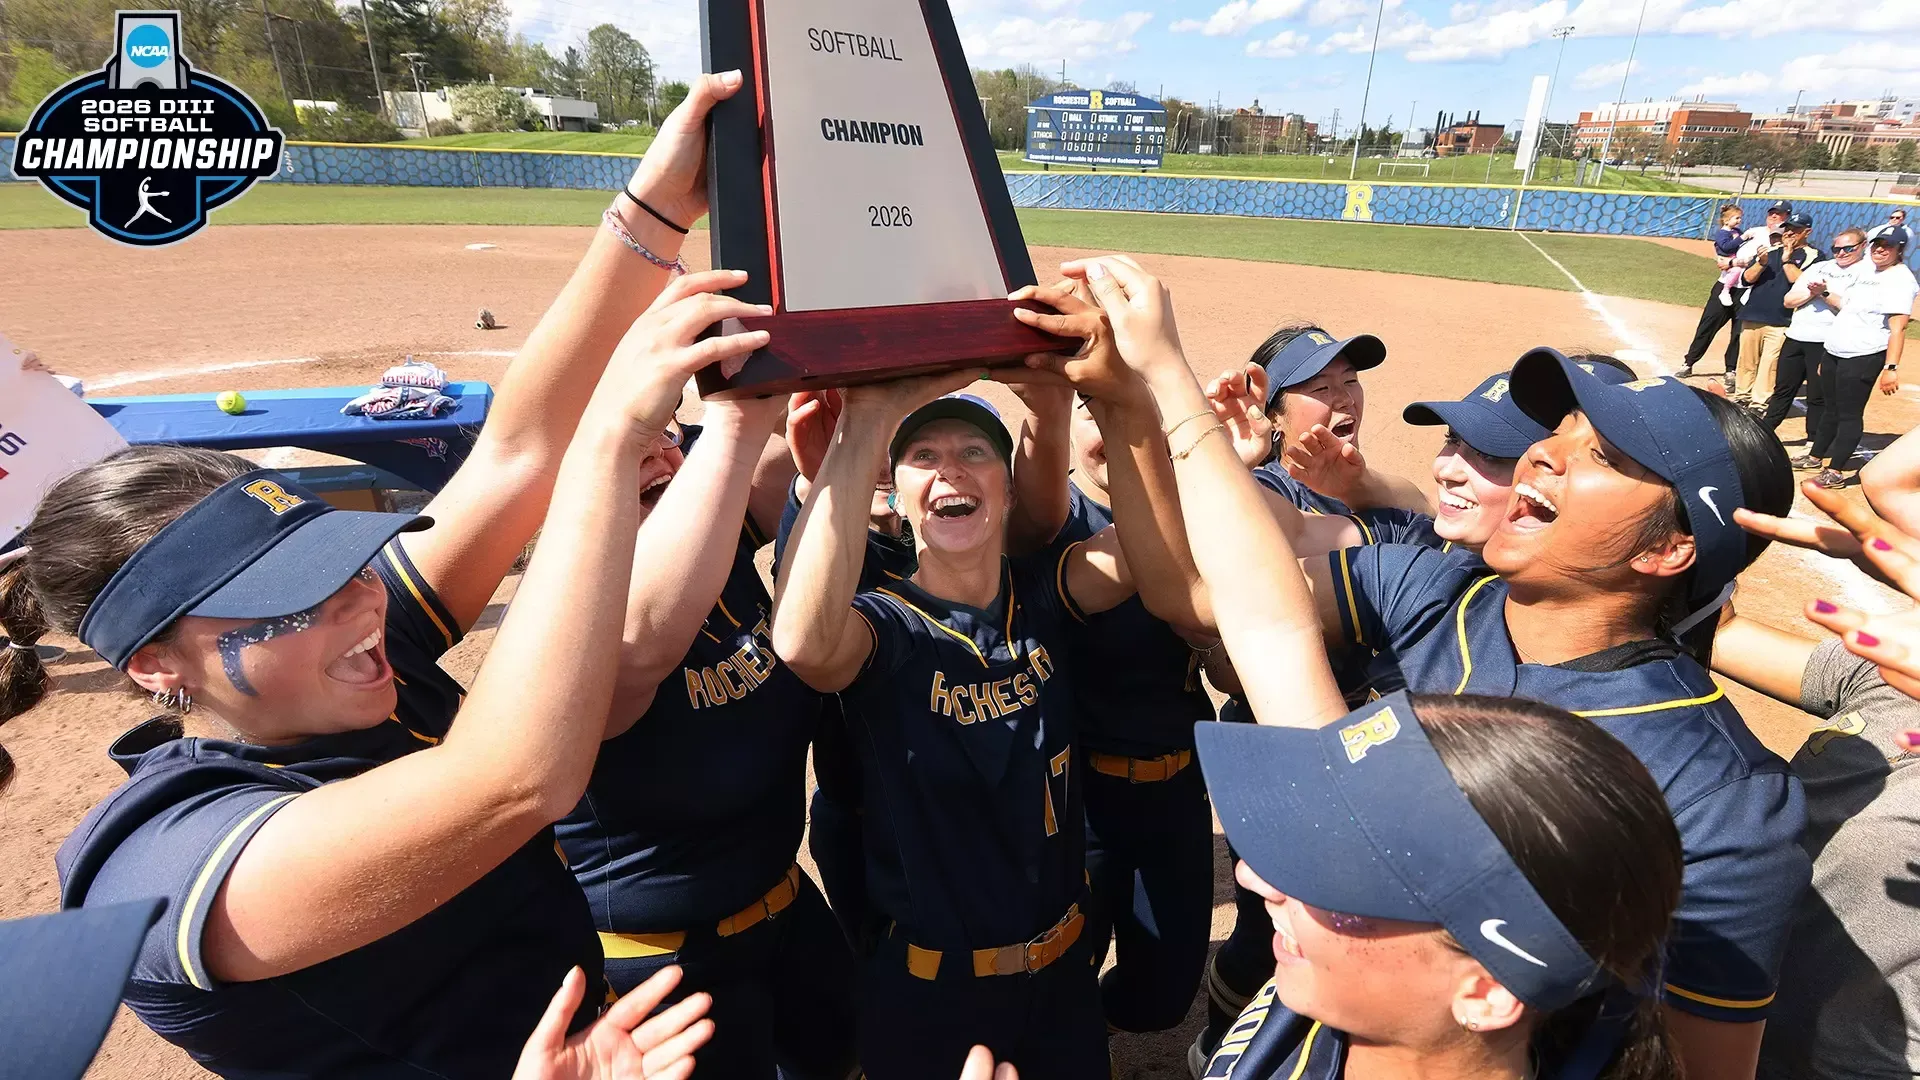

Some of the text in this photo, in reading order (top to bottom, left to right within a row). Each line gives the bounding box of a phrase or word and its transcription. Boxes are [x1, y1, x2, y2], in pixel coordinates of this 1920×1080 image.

[807, 27, 903, 61] SOFTBALL
[1052, 95, 1089, 105] ROCHESTER
[1104, 97, 1137, 107] SOFTBALL
[820, 117, 924, 146] CHAMPION
[1069, 113, 1083, 122] BALL
[1098, 114, 1119, 123] STRIKE
[1132, 115, 1144, 124] OUT
[868, 205, 913, 228] 2026
[1341, 184, 1373, 221] R
[240, 478, 307, 517] R
[684, 602, 775, 709] ROCHEST
[1339, 705, 1401, 764] R
